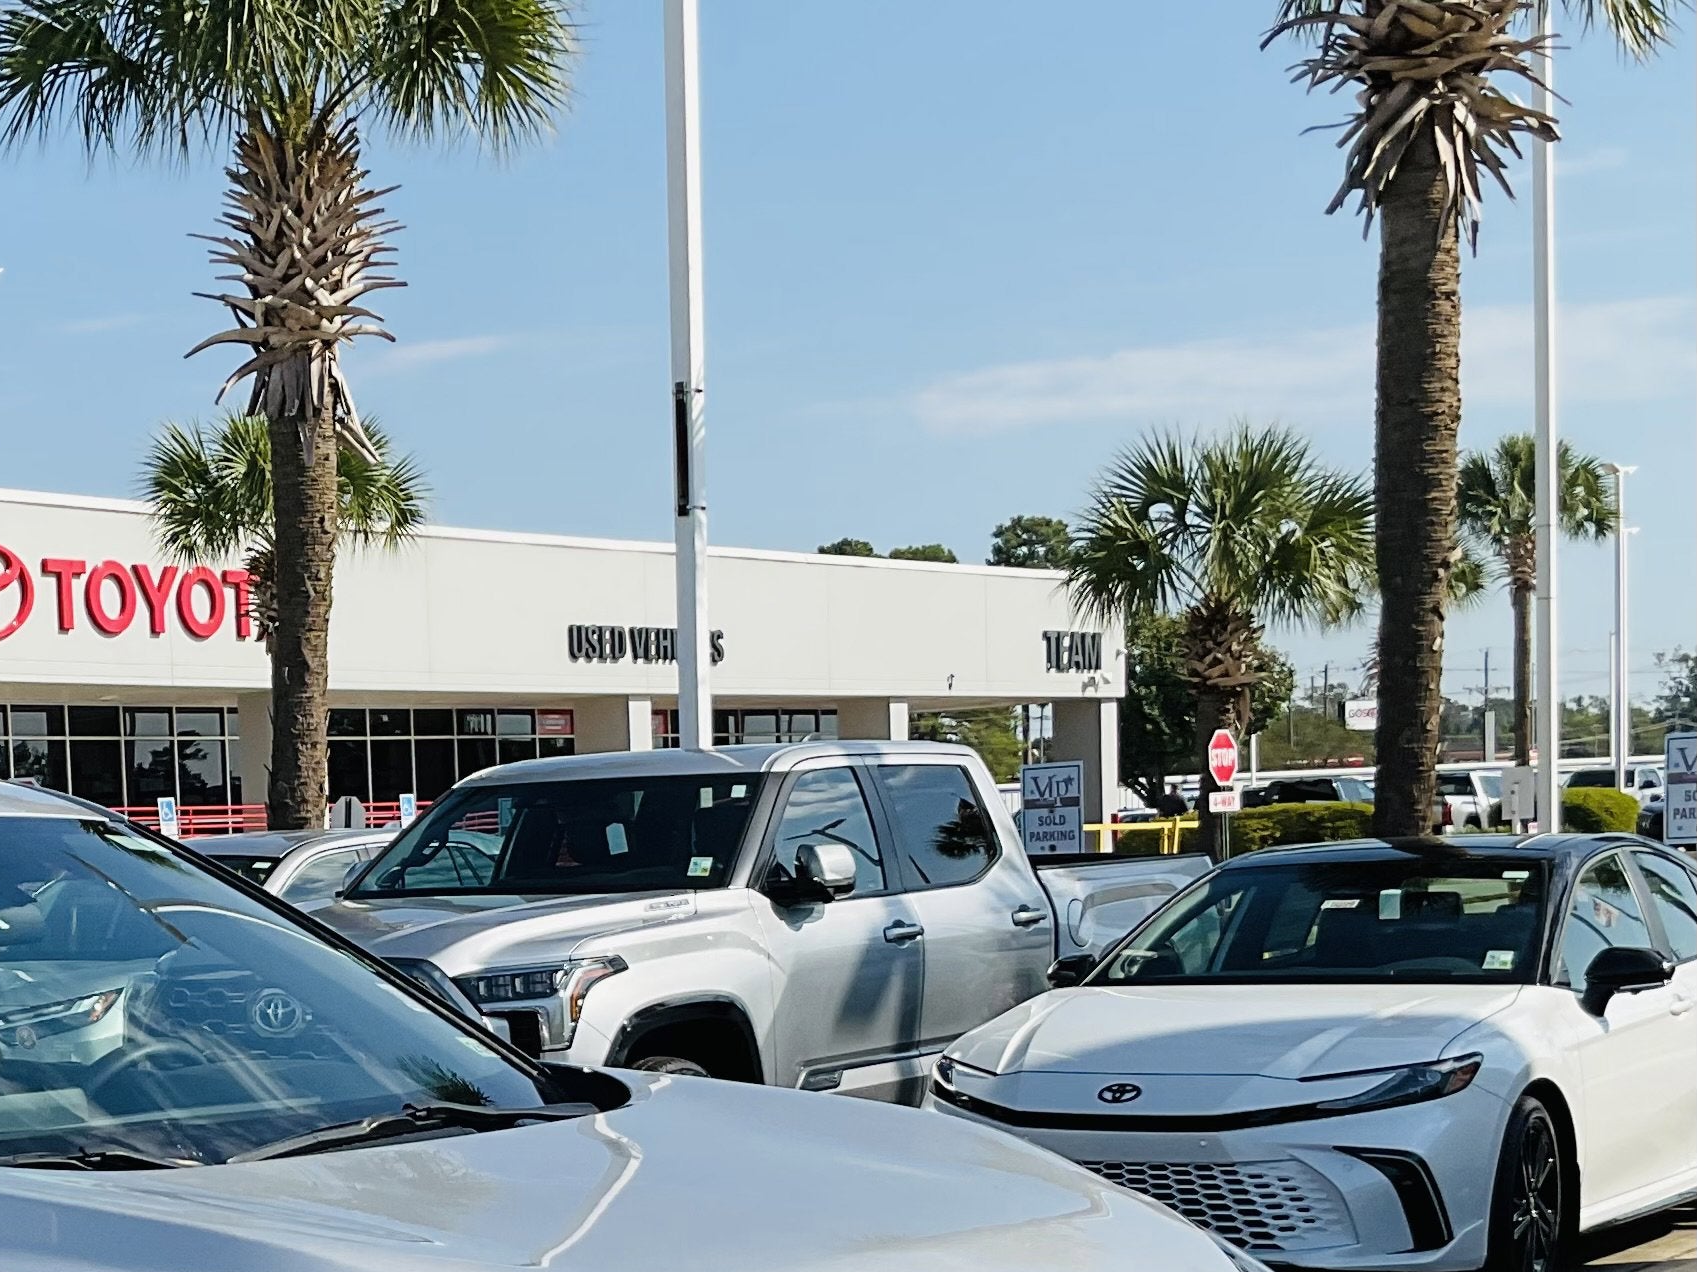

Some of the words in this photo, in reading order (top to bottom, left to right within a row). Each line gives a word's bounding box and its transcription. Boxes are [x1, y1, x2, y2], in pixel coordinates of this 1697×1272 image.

[41, 558, 261, 638] TOYOT
[568, 624, 627, 662] USED
[628, 626, 724, 665] VEHIS
[1042, 630, 1102, 673] TEAM
[1211, 748, 1236, 767] STOP
[1029, 829, 1076, 842] PARKING
[1037, 814, 1066, 827] SOLD
